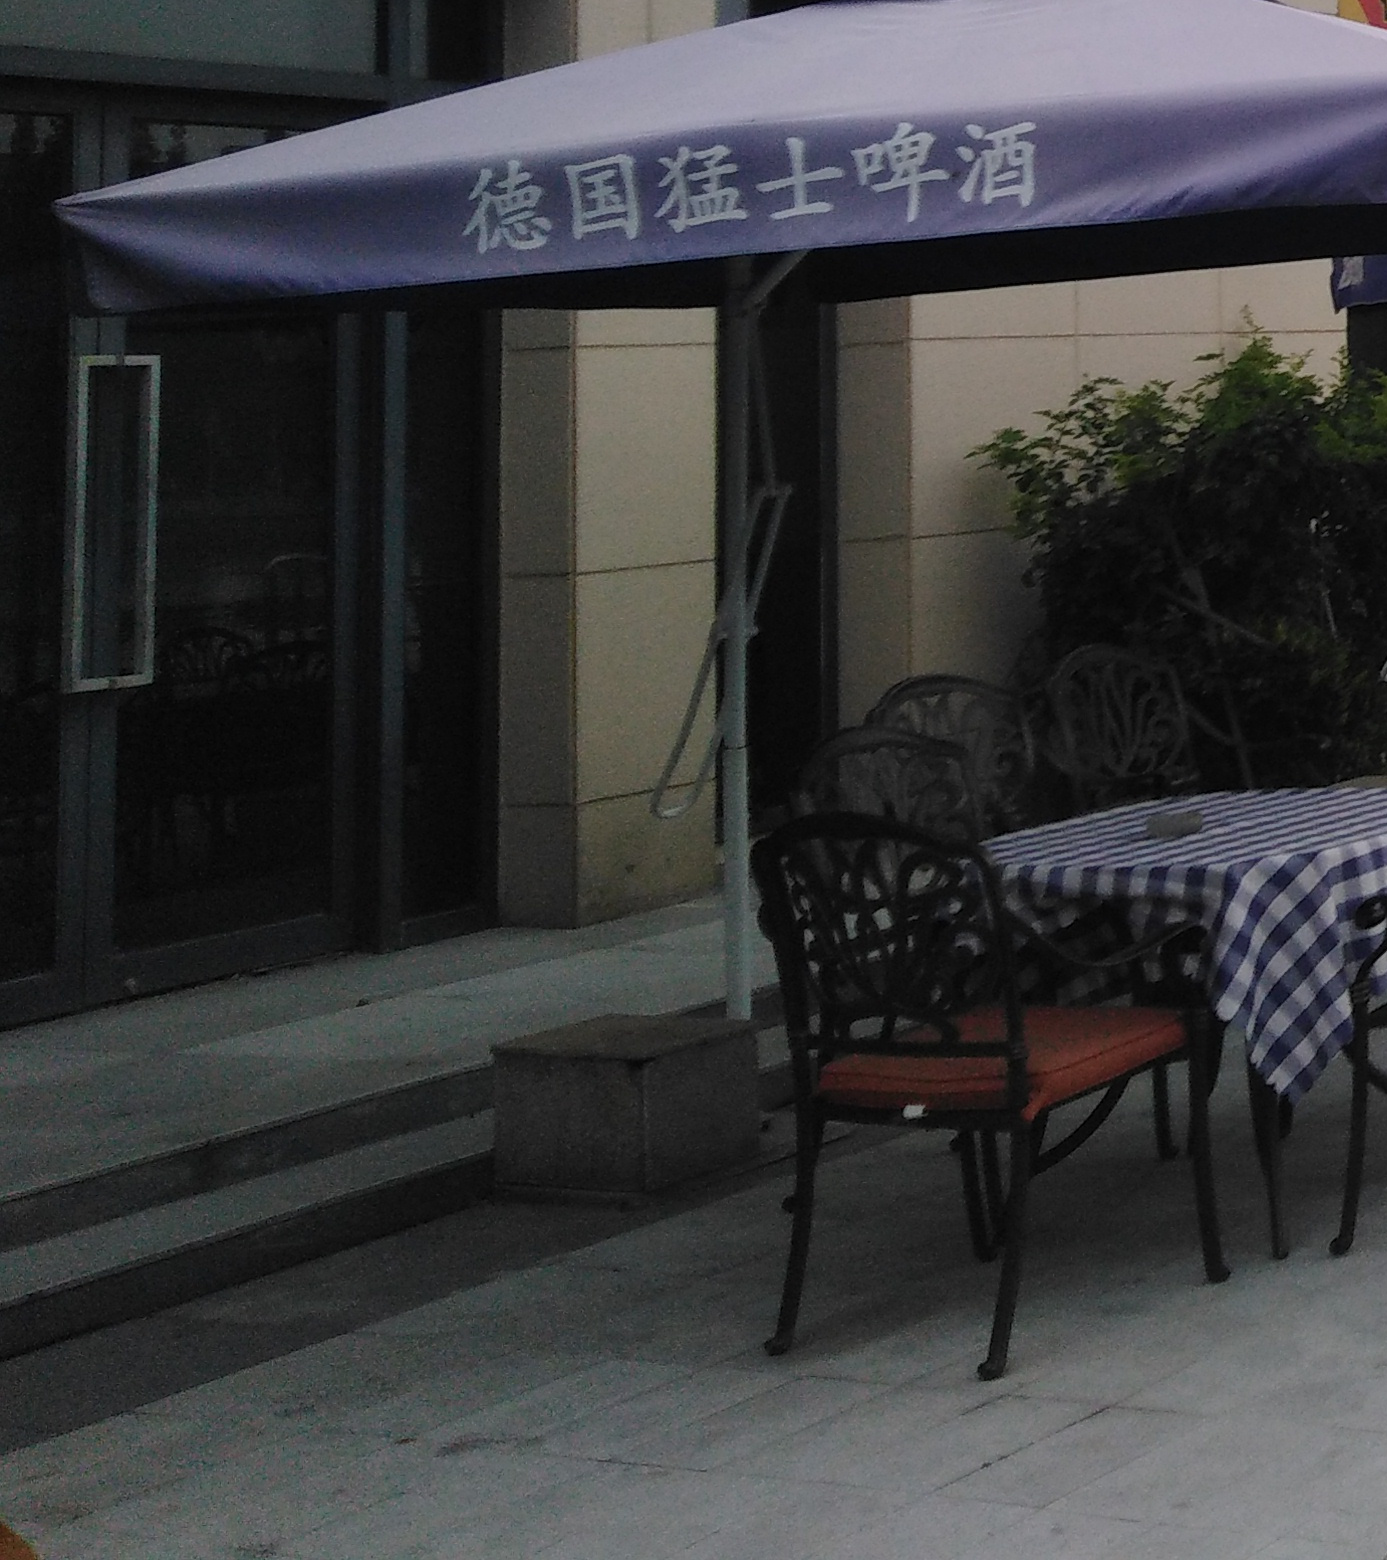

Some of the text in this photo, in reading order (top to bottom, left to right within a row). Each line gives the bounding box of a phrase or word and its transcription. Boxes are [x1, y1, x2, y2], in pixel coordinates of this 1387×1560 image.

[461, 120, 1038, 255] 德国猛士啤酒
